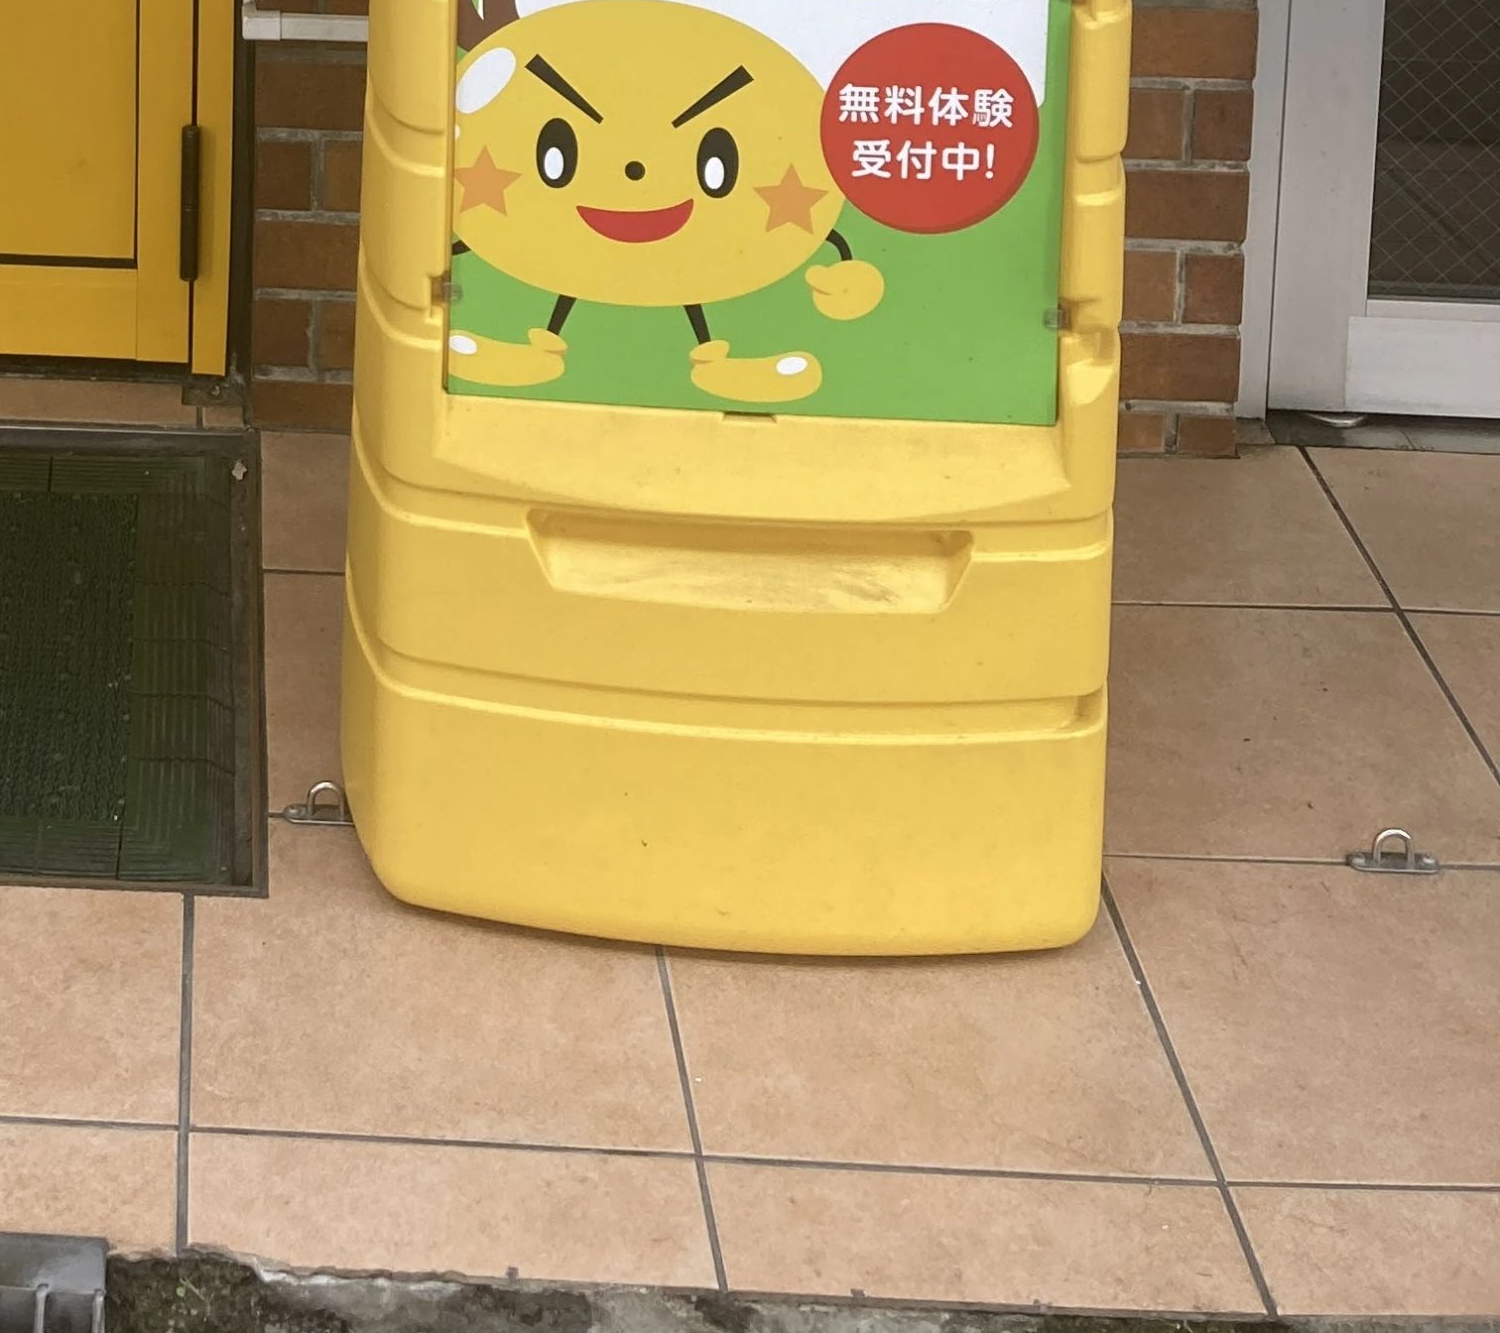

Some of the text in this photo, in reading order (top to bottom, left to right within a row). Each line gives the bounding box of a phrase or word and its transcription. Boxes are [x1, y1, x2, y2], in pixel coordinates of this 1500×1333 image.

[838, 83, 1015, 128] 無料体験
[851, 139, 995, 181] 受付中!
